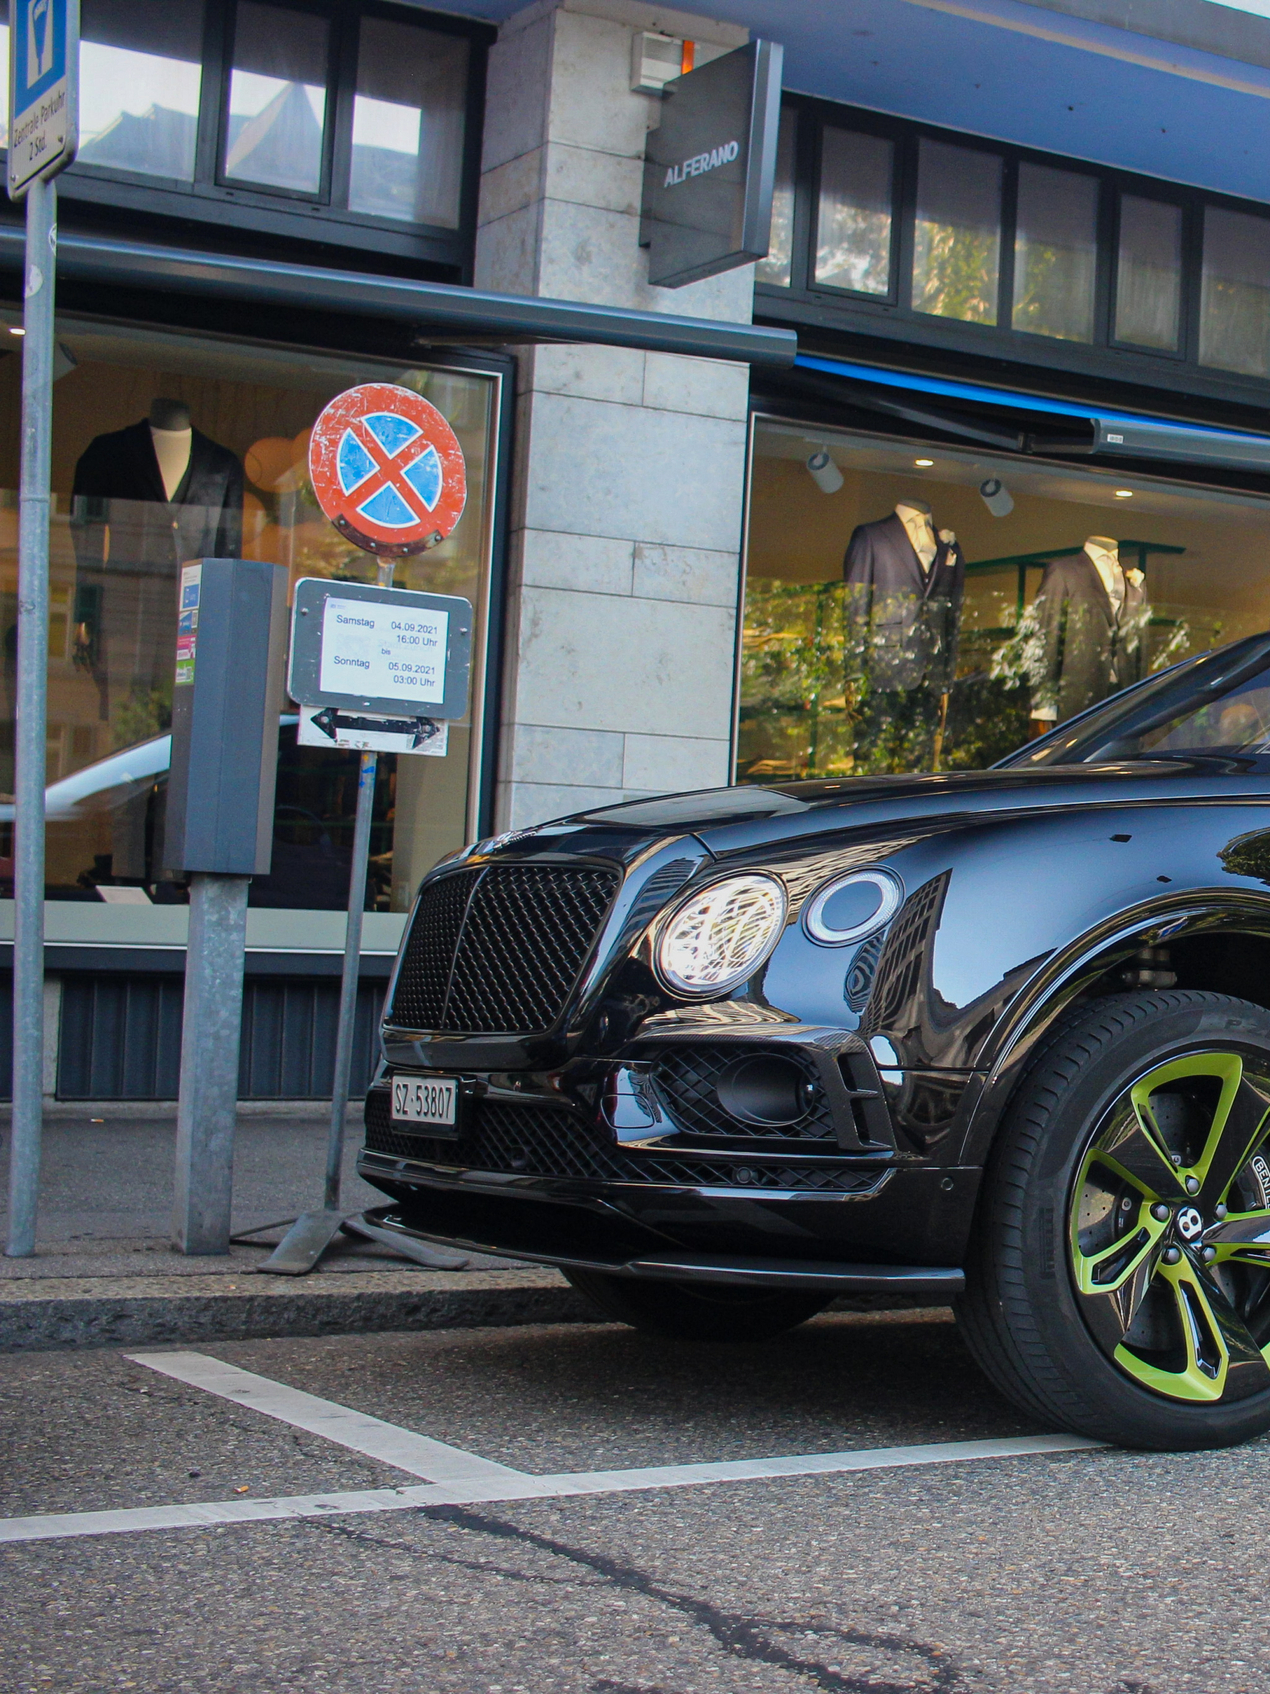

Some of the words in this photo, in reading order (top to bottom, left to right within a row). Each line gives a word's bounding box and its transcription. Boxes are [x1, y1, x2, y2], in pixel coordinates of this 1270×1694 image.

[13, 112, 39, 148] Zentrale
[40, 91, 66, 126] Parkuhr
[29, 142, 34, 162] 2
[664, 140, 739, 188] ALFERANO
[336, 615, 375, 629] Samstag
[391, 621, 438, 635] 04.09.2021
[396, 634, 420, 645] 16:00
[422, 636, 438, 648] Uhr
[381, 647, 391, 655] bis
[333, 656, 370, 670] Sonntag
[388, 661, 435, 675] 05.09.2021
[393, 674, 417, 686] 03:00
[419, 676, 436, 688] Uhr
